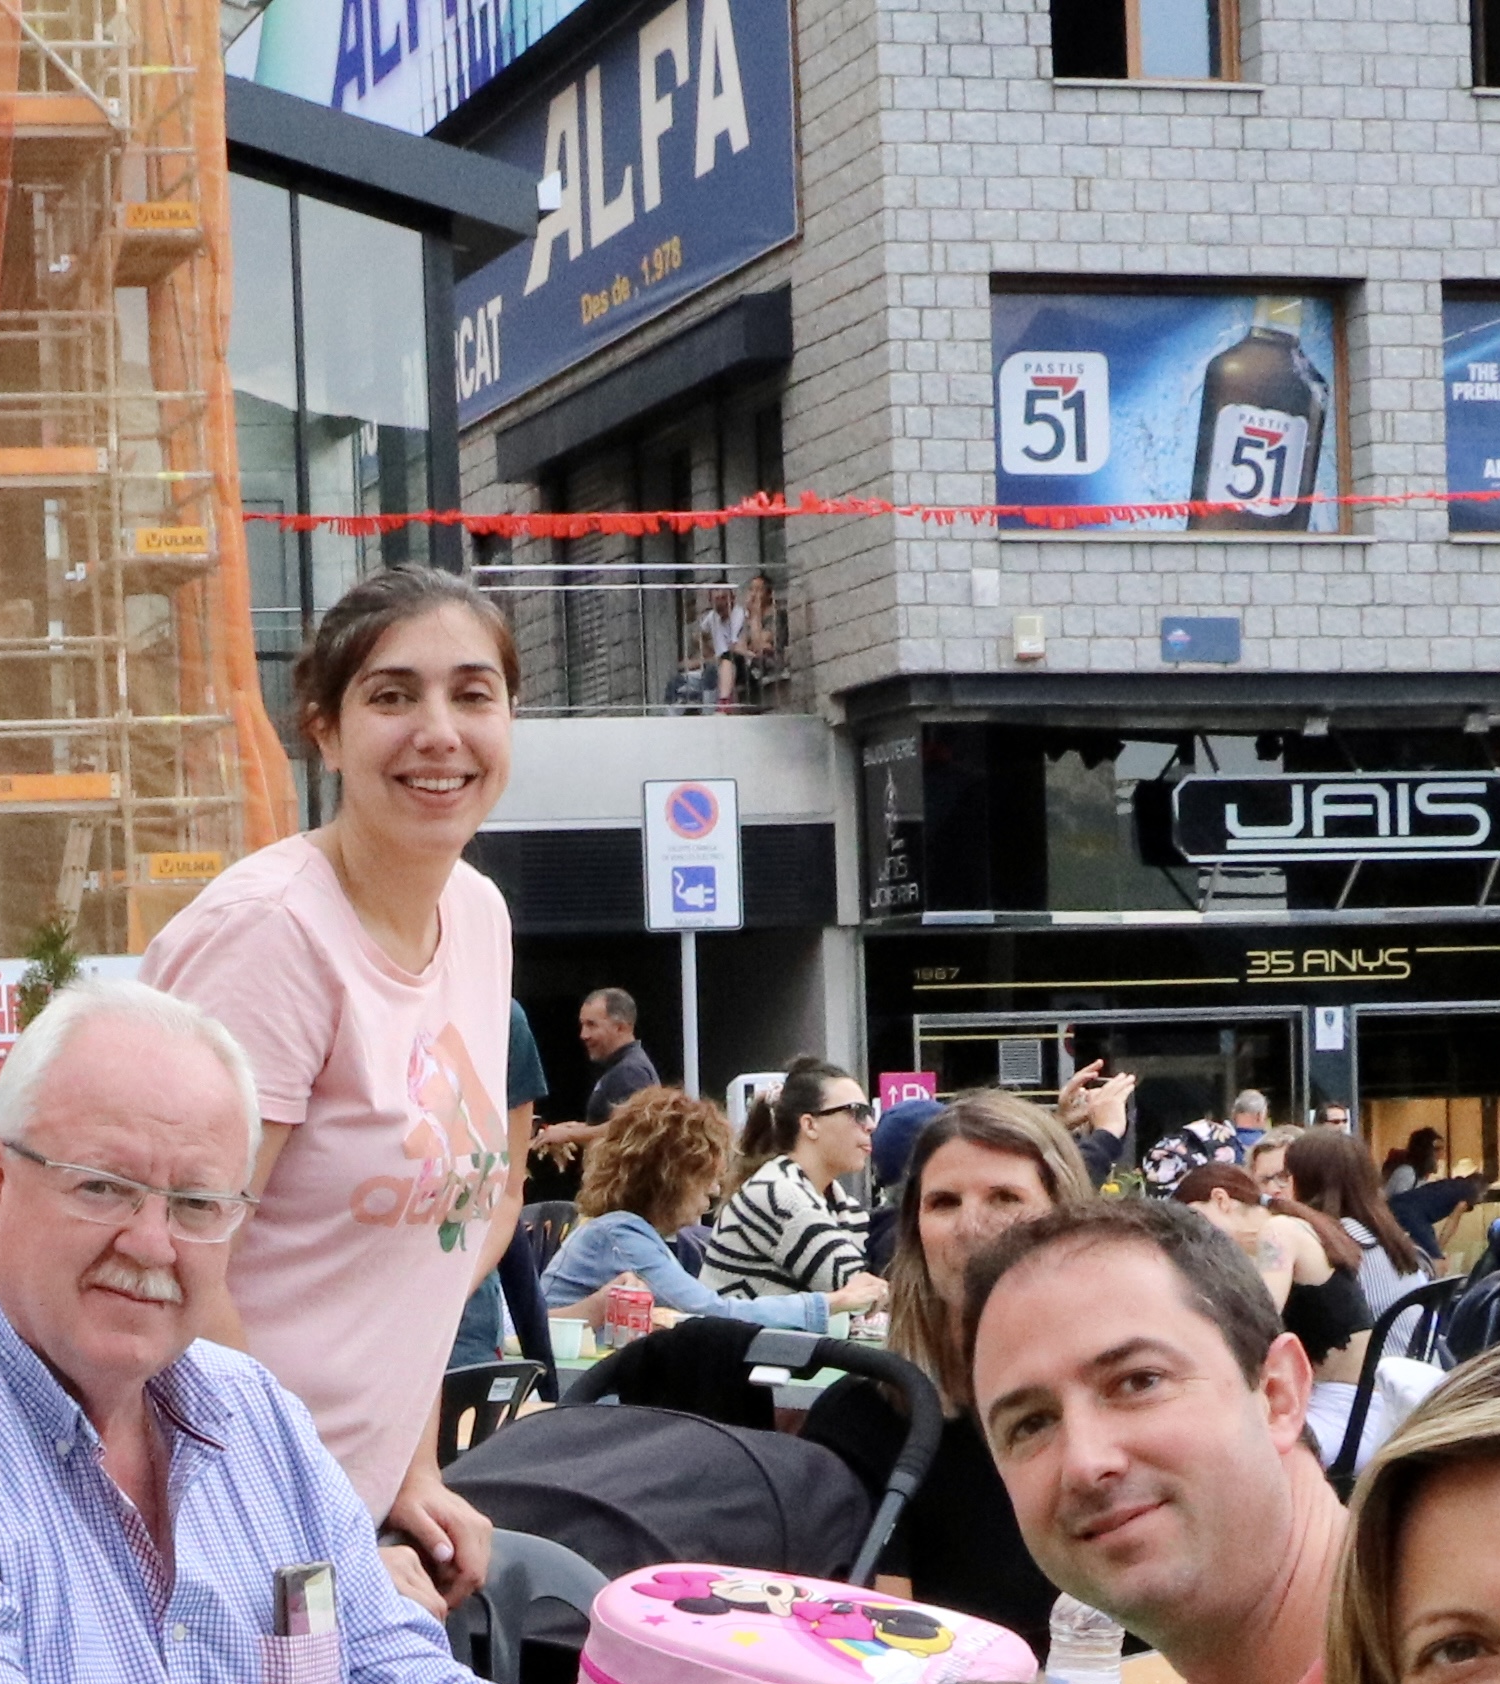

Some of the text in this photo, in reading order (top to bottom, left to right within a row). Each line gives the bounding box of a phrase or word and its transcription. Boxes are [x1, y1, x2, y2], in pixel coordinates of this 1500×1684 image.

[523, 0, 751, 297] ALFA
[1023, 363, 1085, 375] PASTIS
[1467, 362, 1498, 381] THE
[1021, 389, 1088, 463] 51
[1238, 413, 1291, 433] PASTIS
[1225, 436, 1288, 507] 51
[164, 532, 206, 547] ULMA
[1225, 781, 1491, 851] JAIS
[175, 860, 216, 873] ULMA
[914, 966, 960, 982] 1987
[1246, 947, 1411, 981] 35 ANYS
